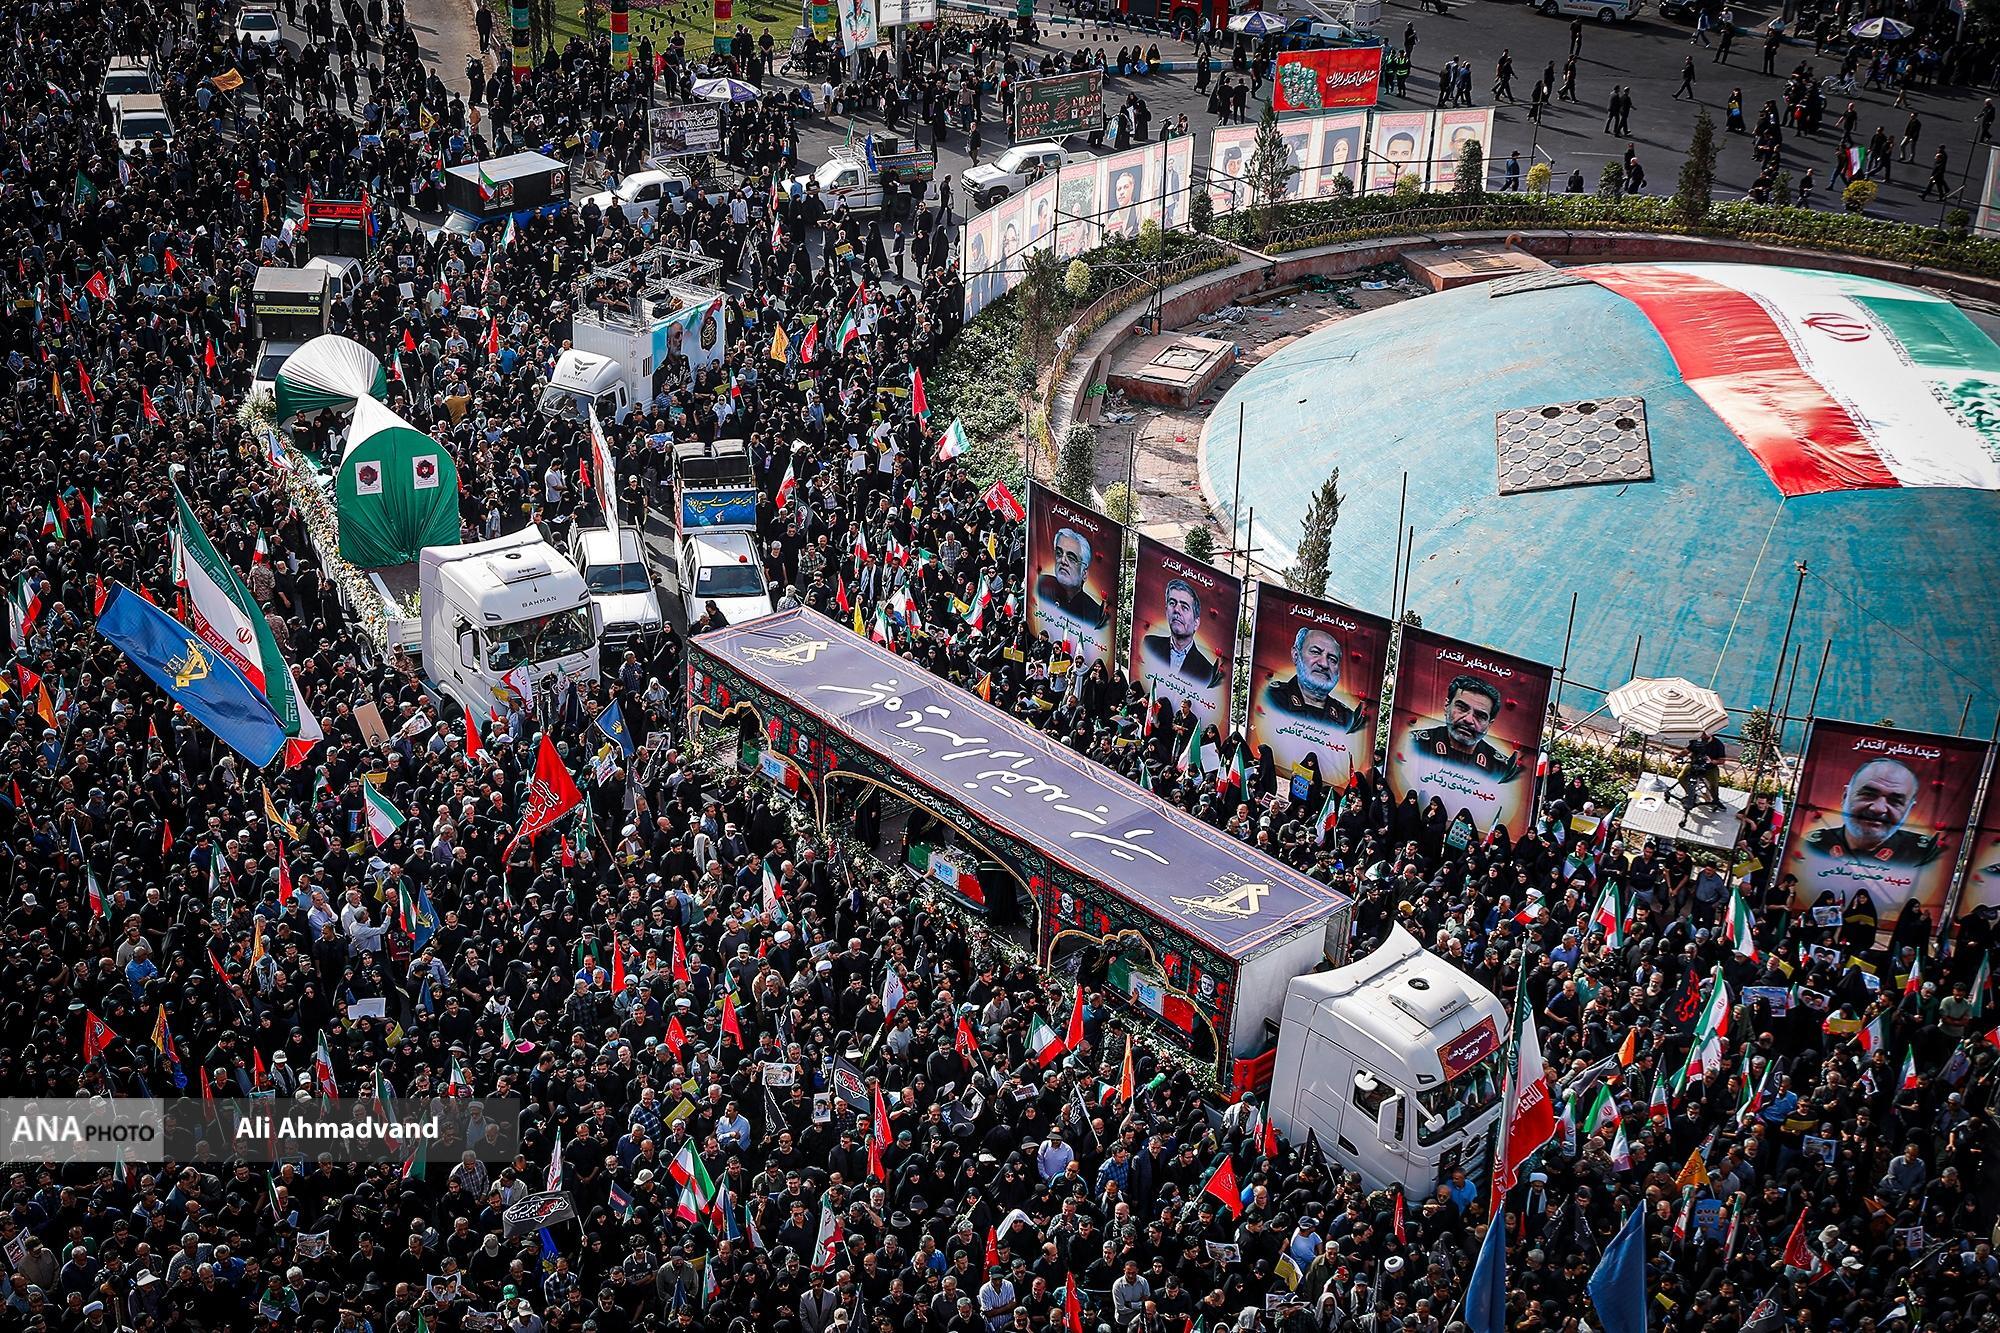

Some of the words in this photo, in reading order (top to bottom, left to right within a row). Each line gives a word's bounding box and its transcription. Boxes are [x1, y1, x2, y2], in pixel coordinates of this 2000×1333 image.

[1051, 504, 1069, 517] اقتدار
[1068, 513, 1083, 525] مظهر
[1083, 518, 1099, 532] شهدا
[1162, 557, 1182, 571] اقتدار
[1180, 567, 1197, 580] مظهر
[1197, 572, 1213, 586] شهدا
[521, 595, 557, 608] BAHMAN
[1289, 604, 1314, 617] اقتدار
[1313, 612, 1335, 624] مظهر
[1335, 616, 1356, 631] شهدا
[1067, 626, 1082, 638] حمد
[1093, 639, 1109, 653] شهید
[1437, 648, 1464, 662] اقتدار
[1466, 658, 1488, 670] مظهر
[1488, 662, 1511, 676] شهدا
[816, 678, 904, 712] سپاه
[1199, 698, 1217, 711] شهید
[1275, 726, 1304, 737] کاظمی
[1302, 733, 1325, 746] محمد
[1325, 740, 1347, 752] شهید
[1852, 738, 1886, 750] اقتدار
[1884, 743, 1912, 755] مظهر
[1914, 746, 1940, 759] شهدا
[1447, 782, 1472, 795] مهدی
[1472, 789, 1496, 802] شهید
[1817, 866, 1852, 877] سلامی
[1851, 873, 1884, 881] حسین
[1884, 876, 1911, 887] شهید
